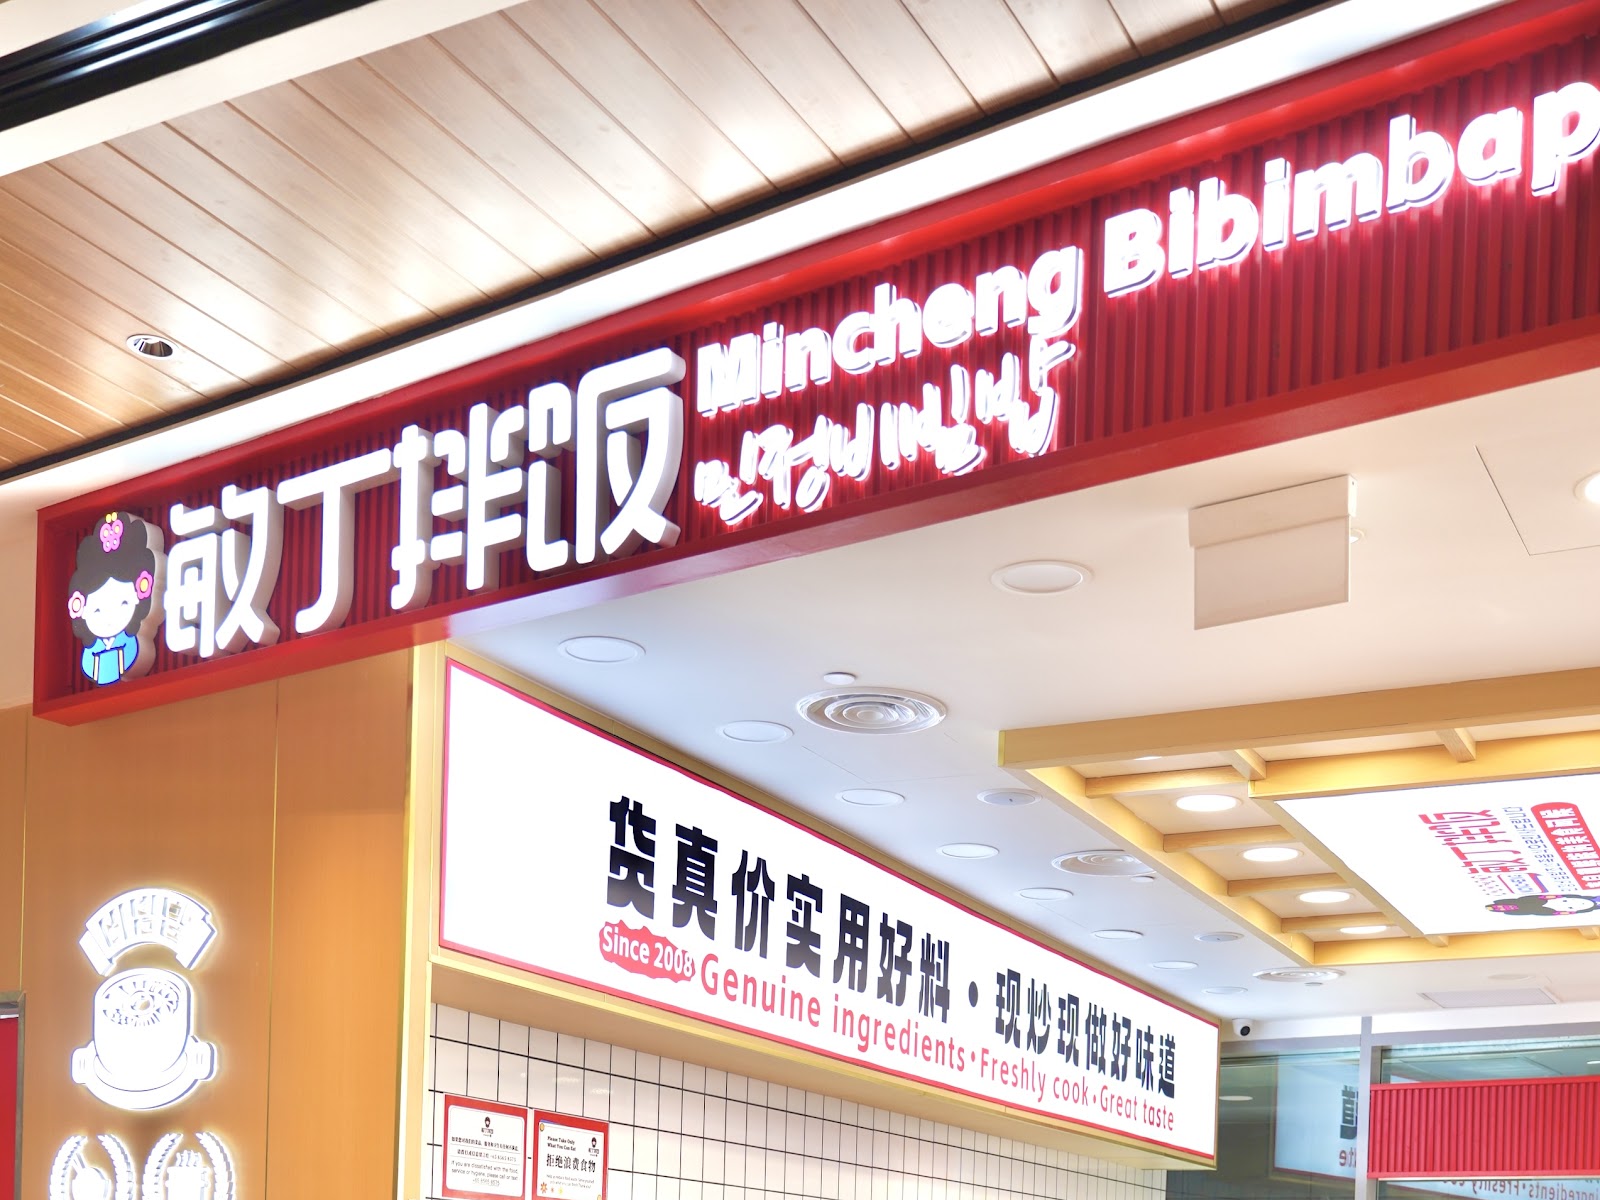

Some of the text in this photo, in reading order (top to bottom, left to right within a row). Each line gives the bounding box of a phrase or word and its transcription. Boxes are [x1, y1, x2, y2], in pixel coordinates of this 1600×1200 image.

[696, 81, 1600, 420] Mincheng Bibimbap
[601, 923, 651, 965] Since
[653, 940, 693, 977] 2008
[700, 952, 822, 1028] Genuine
[1142, 1100, 1176, 1133] taste
[546, 1153, 596, 1173] 拒绝浪费食物
